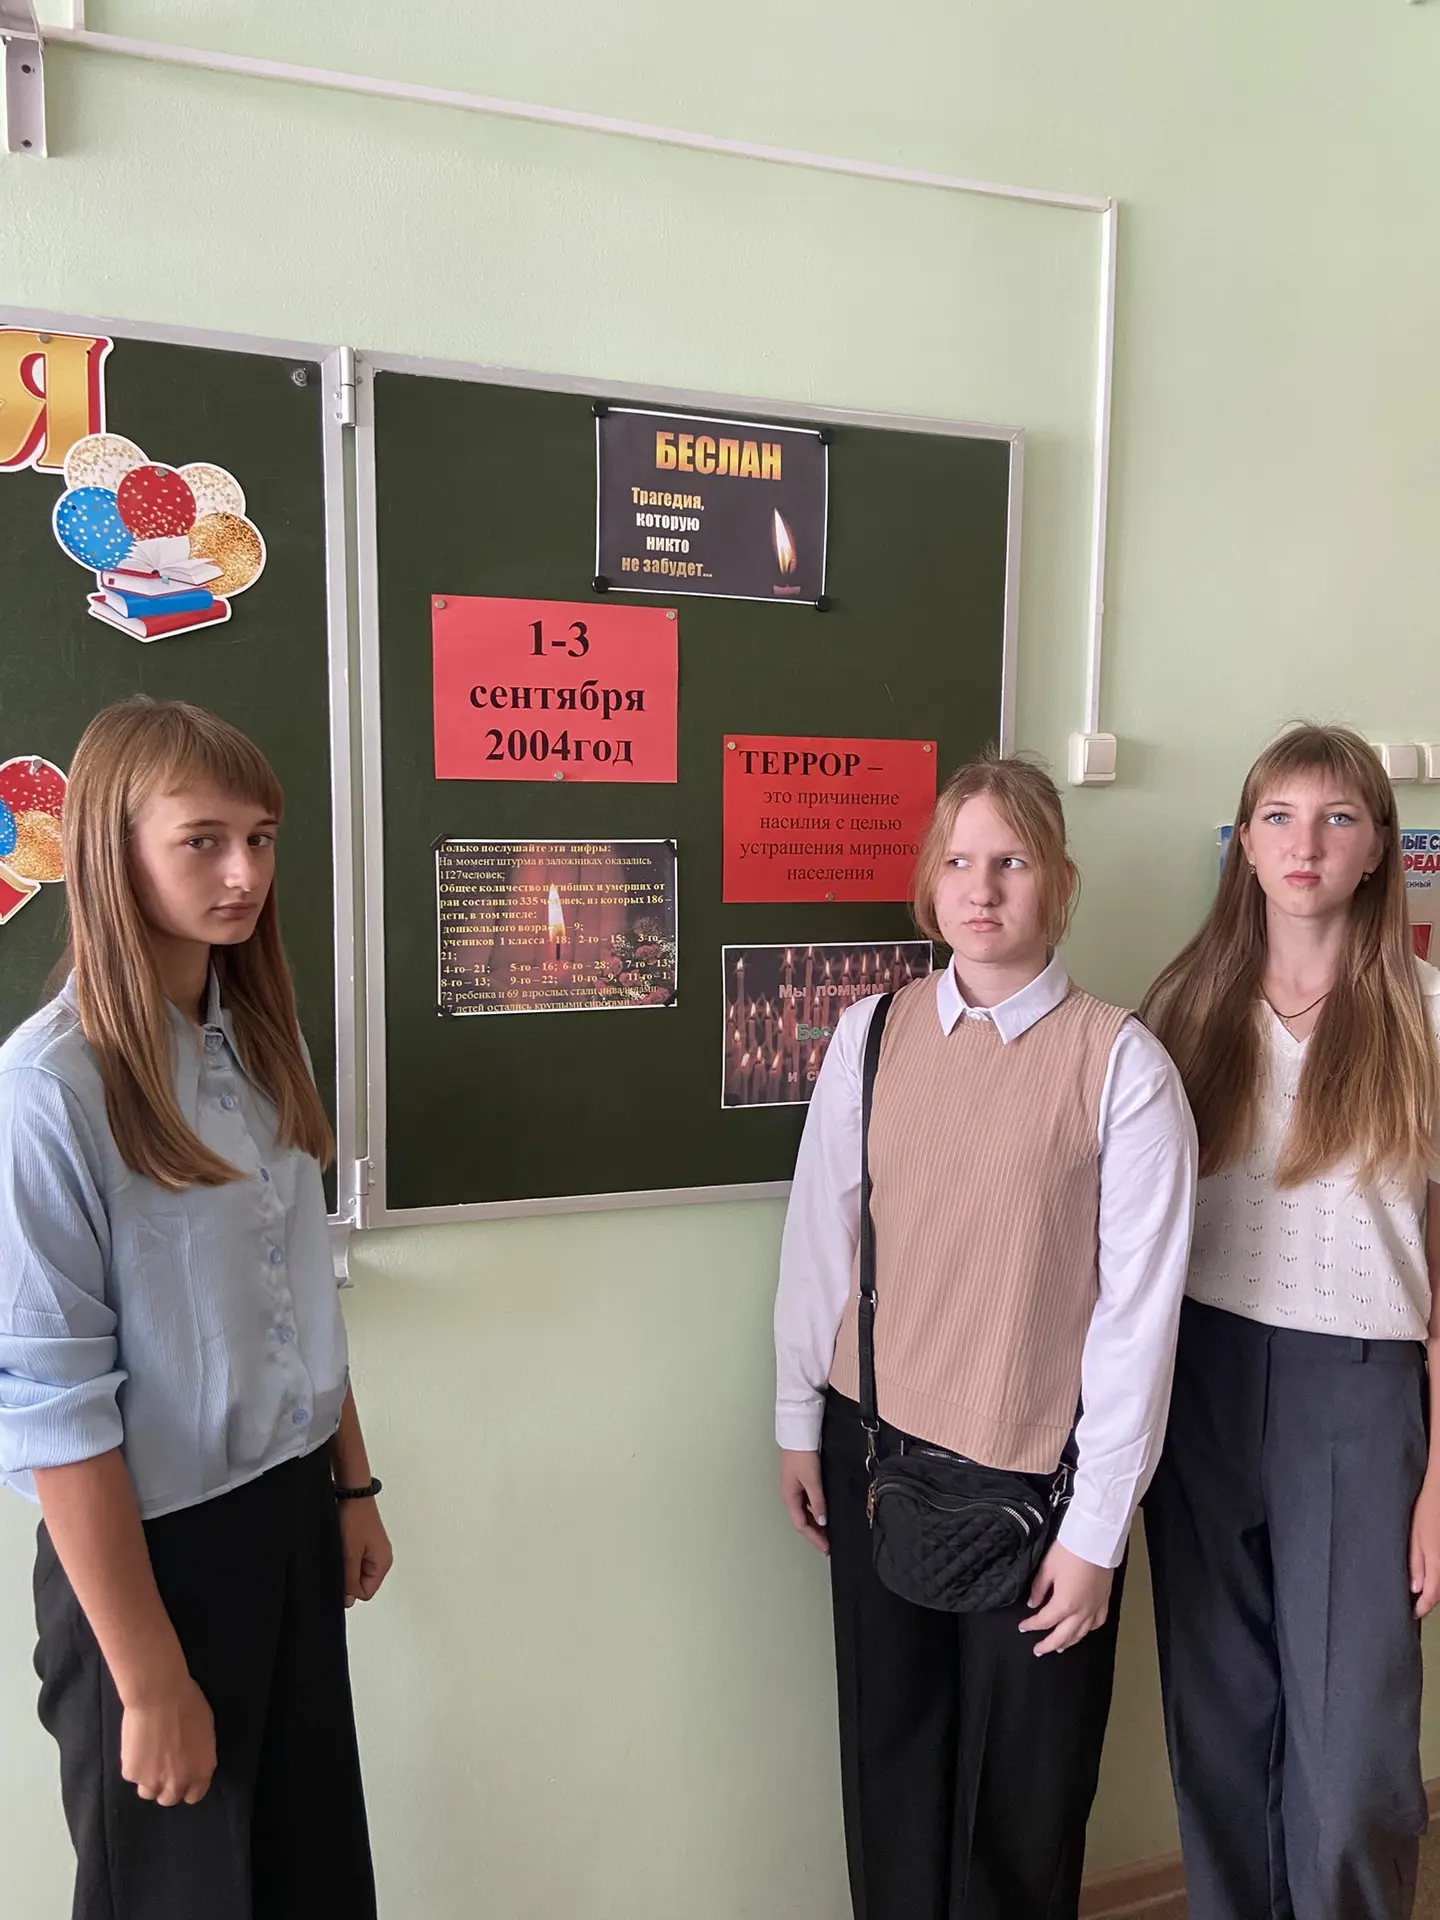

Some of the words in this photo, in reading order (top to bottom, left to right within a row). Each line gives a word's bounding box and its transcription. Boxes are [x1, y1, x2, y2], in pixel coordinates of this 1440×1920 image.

[0, 329, 108, 468] Я
[656, 431, 782, 480] БЕСЛАН
[631, 486, 704, 510] Трагедия,
[636, 512, 700, 532] которую
[646, 536, 690, 554] никто
[621, 556, 639, 572] не
[642, 558, 713, 578] забудет...
[528, 620, 590, 657] 1-3
[469, 679, 645, 720] сентября
[485, 728, 633, 766] 2004год
[738, 750, 861, 777] ТЕРРОР
[763, 791, 792, 804] это
[797, 792, 900, 808] причинение
[759, 816, 830, 829] насилия
[835, 818, 845, 829] с
[850, 818, 902, 833] целью
[440, 844, 479, 853] Только
[481, 844, 546, 855] послушайте
[548, 845, 565, 853] эти
[571, 844, 611, 855] цифры:
[740, 842, 844, 859] устрашения
[850, 842, 919, 859] мирного
[439, 857, 453, 866] На
[456, 858, 495, 866] момент
[497, 858, 536, 868] штурма
[546, 858, 602, 867] заложниках
[605, 857, 652, 866] оказались
[787, 867, 874, 880] населения
[440, 883, 478, 894] Общее
[479, 884, 541, 893] количество
[597, 884, 603, 892] и
[604, 884, 651, 893] умерших
[440, 899, 460, 909] ран
[462, 898, 518, 907] составило
[520, 896, 538, 906] 335
[540, 897, 585, 907] чеовек,
[587, 897, 598, 905] из
[600, 896, 644, 907] которых
[646, 895, 664, 904] 186
[440, 912, 468, 921] дети,
[470, 912, 476, 920] в
[480, 912, 500, 920] том
[502, 911, 537, 919] числе:
[443, 925, 516, 934] дошкольного
[443, 938, 495, 949] учеников
[500, 937, 505, 946] 1
[508, 937, 545, 946] класса
[556, 935, 571, 945] 18;
[579, 935, 599, 944] 2-го
[611, 934, 626, 943] 15;
[638, 933, 658, 942] 3-го
[441, 951, 457, 961] 21;
[473, 964, 491, 974] 21;
[510, 963, 531, 972] 5-го
[542, 962, 558, 971] 16;
[562, 961, 583, 970] 6-го
[594, 960, 610, 970] 28;
[626, 960, 646, 968] 7-го
[441, 978, 463, 987] 8-го
[474, 977, 491, 987] 13;
[510, 976, 531, 985] 9-го
[541, 975, 558, 985] 22;
[572, 974, 597, 983] 10-го
[441, 991, 453, 1001] 72
[455, 991, 496, 1002] ребенка
[498, 991, 505, 999] и
[507, 989, 519, 998] 69
[522, 988, 568, 999] взрослых
[571, 987, 597, 996] стали
[779, 984, 807, 998] Мы
[816, 984, 884, 996] помним
[487, 1003, 532, 1012] остались
[534, 1001, 584, 1011] круглыми
[797, 1023, 836, 1041] Бес
[787, 1071, 799, 1083] и
